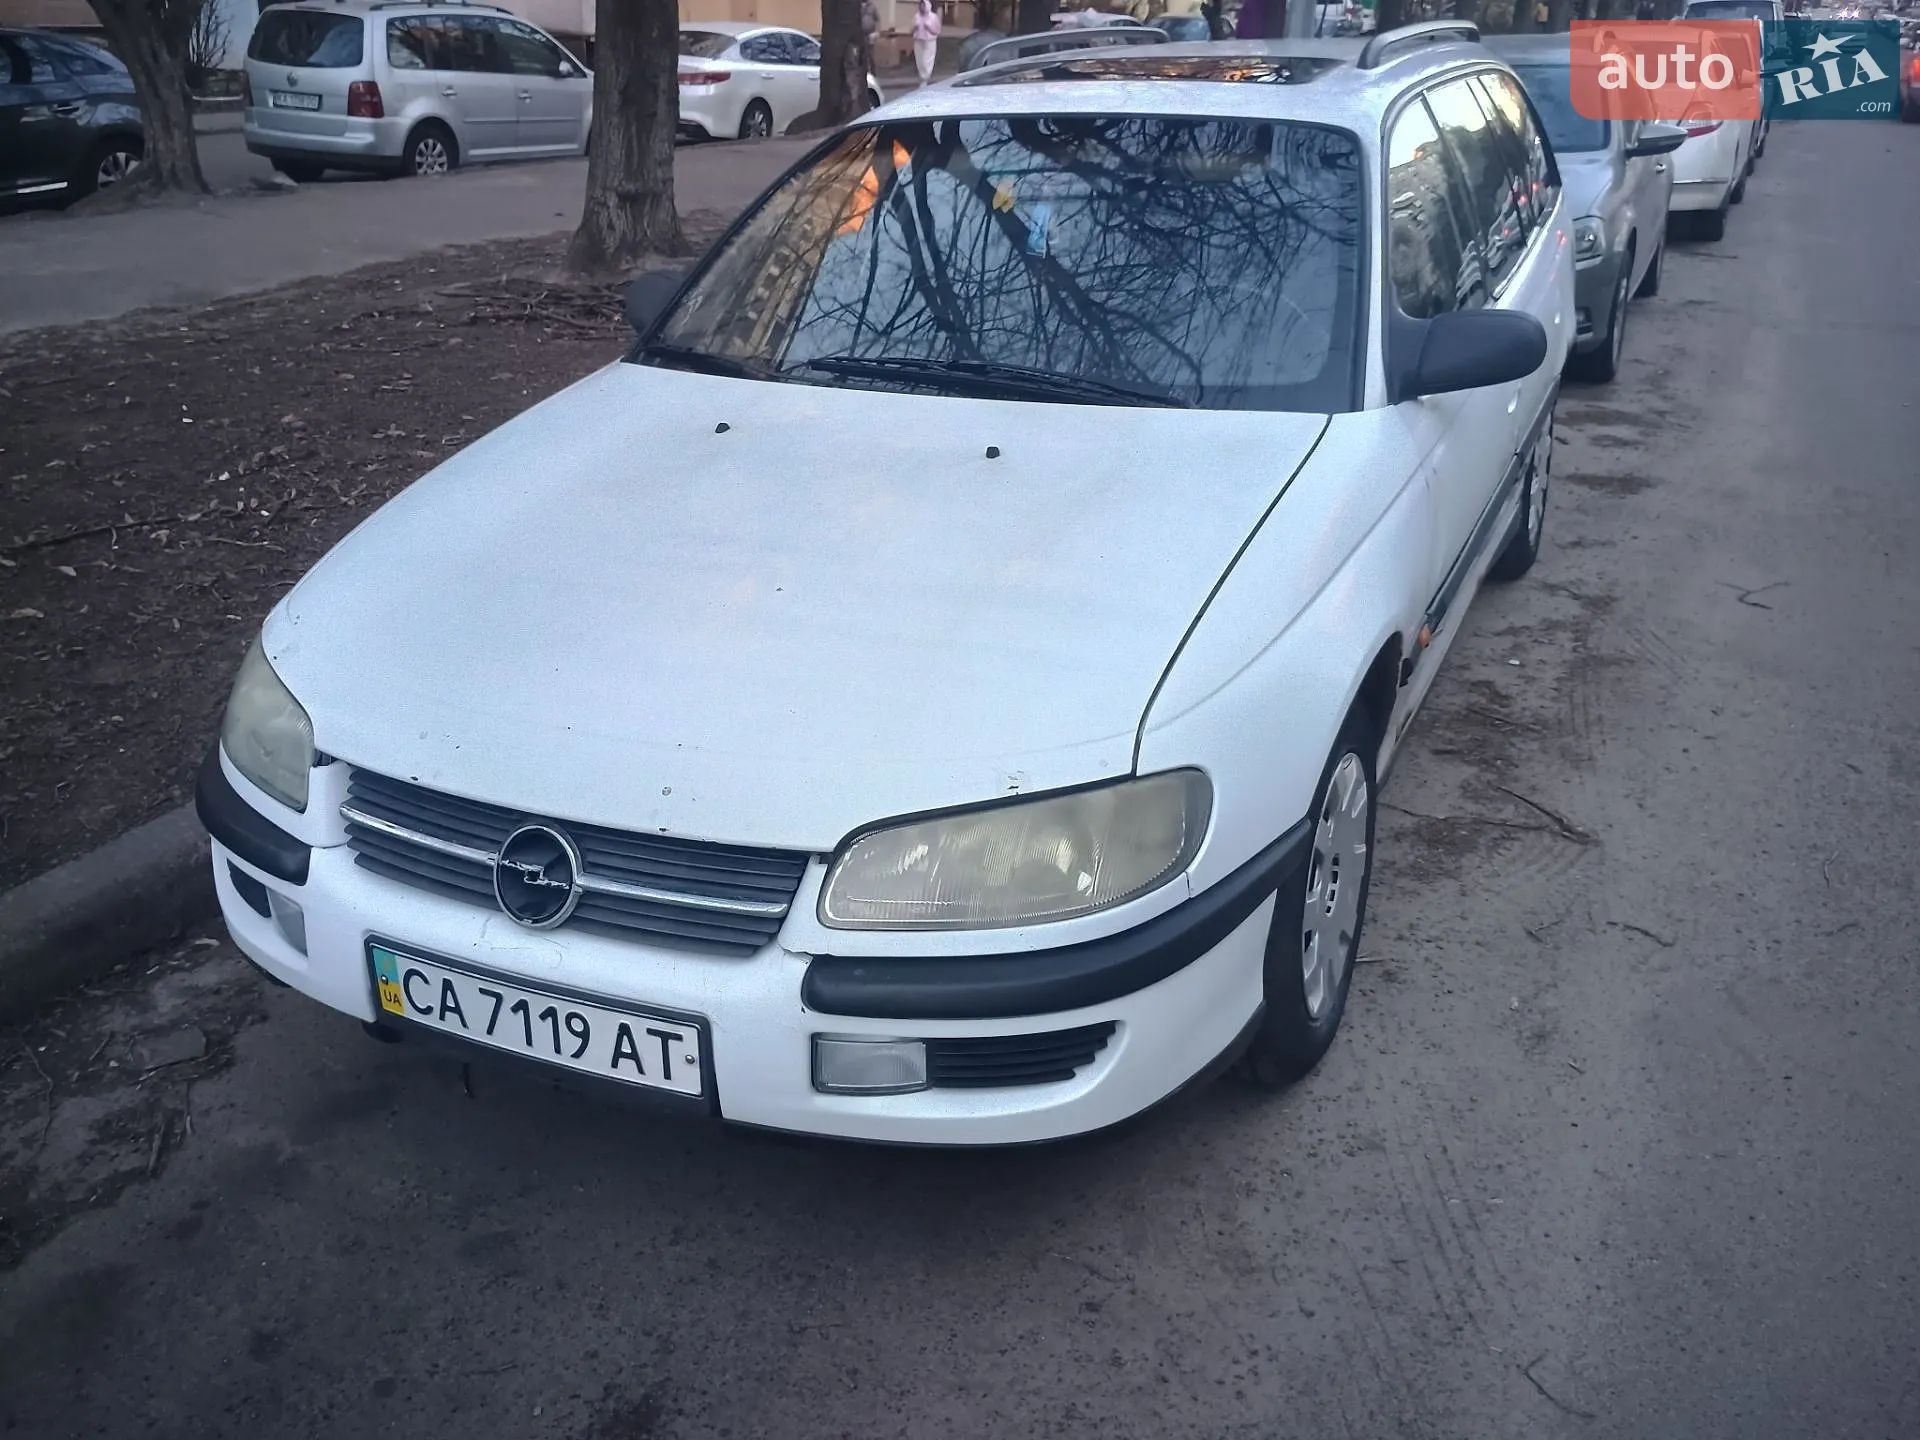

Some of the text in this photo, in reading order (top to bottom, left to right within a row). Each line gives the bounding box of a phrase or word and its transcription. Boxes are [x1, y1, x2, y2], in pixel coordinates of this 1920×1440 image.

[383, 990, 401, 1008] UA
[402, 968, 683, 1081] CA 7119 AT
